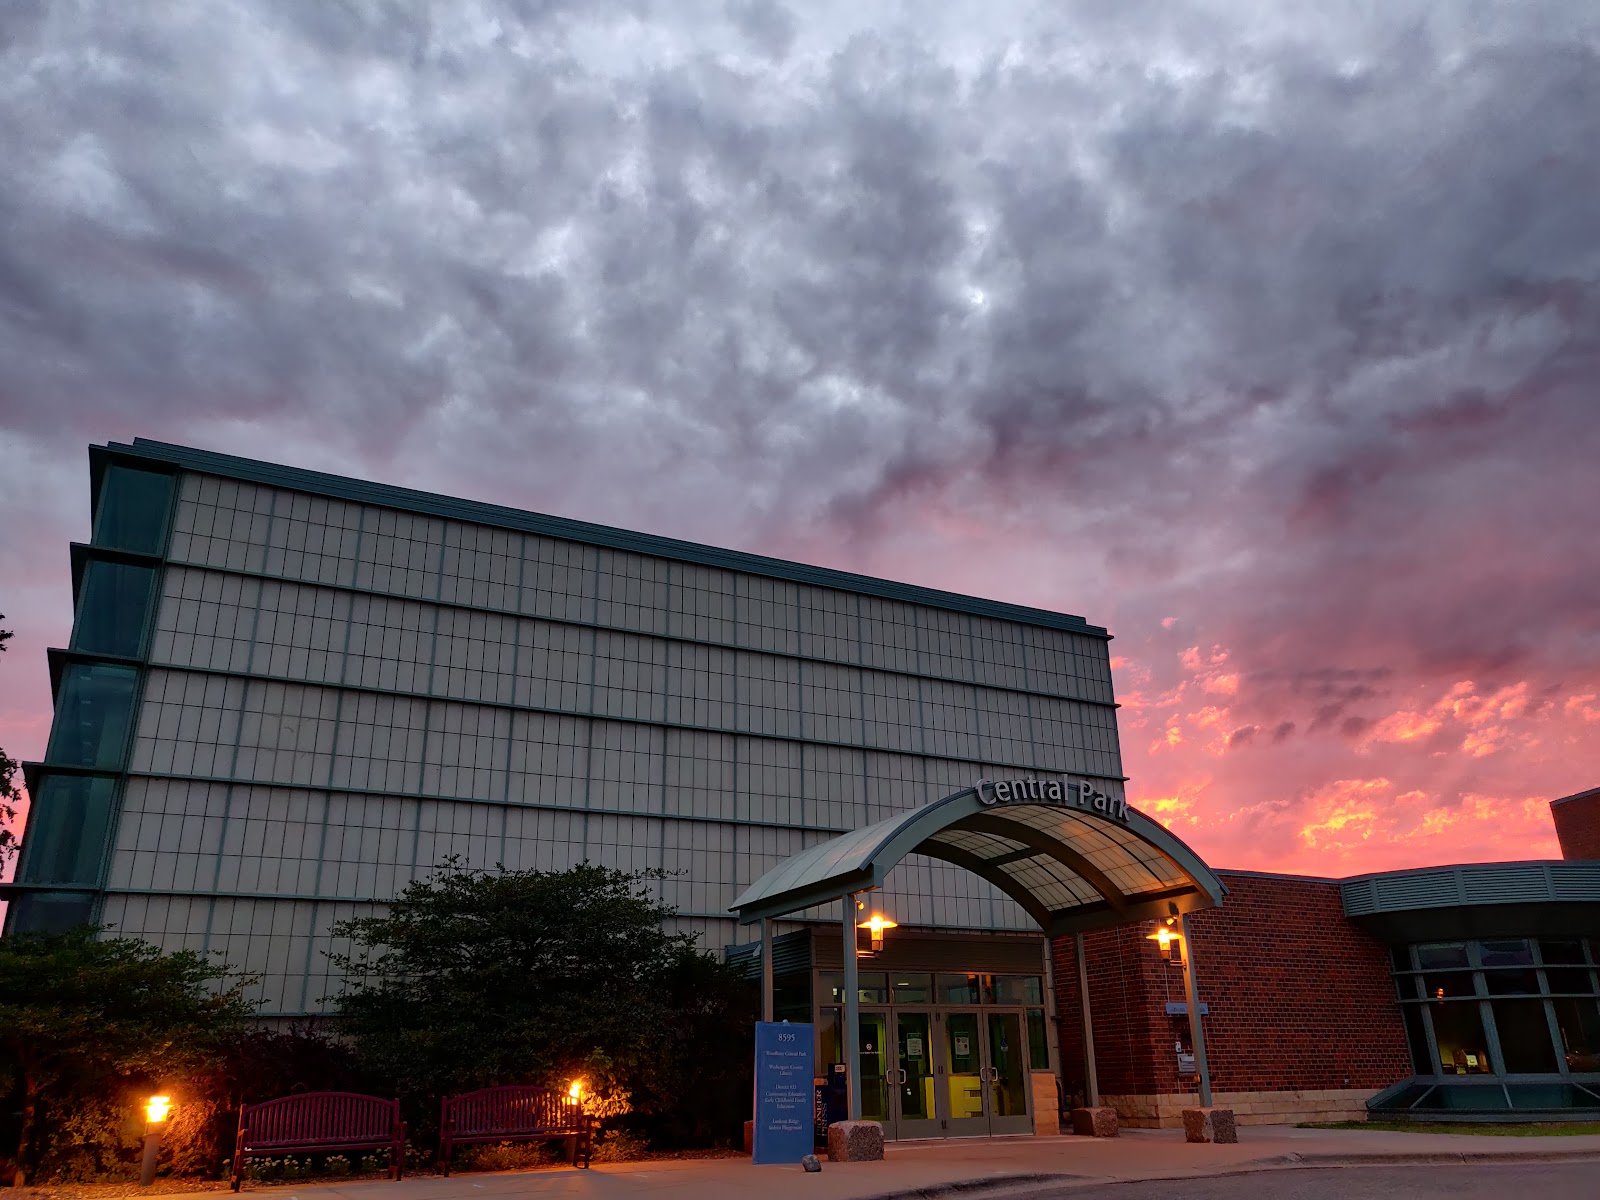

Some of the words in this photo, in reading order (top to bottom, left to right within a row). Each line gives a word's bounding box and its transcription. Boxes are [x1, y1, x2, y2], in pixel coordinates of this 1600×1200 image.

[976, 773, 1069, 805] Central
[1079, 780, 1130, 822] Park
[778, 1033, 796, 1042] 8595
